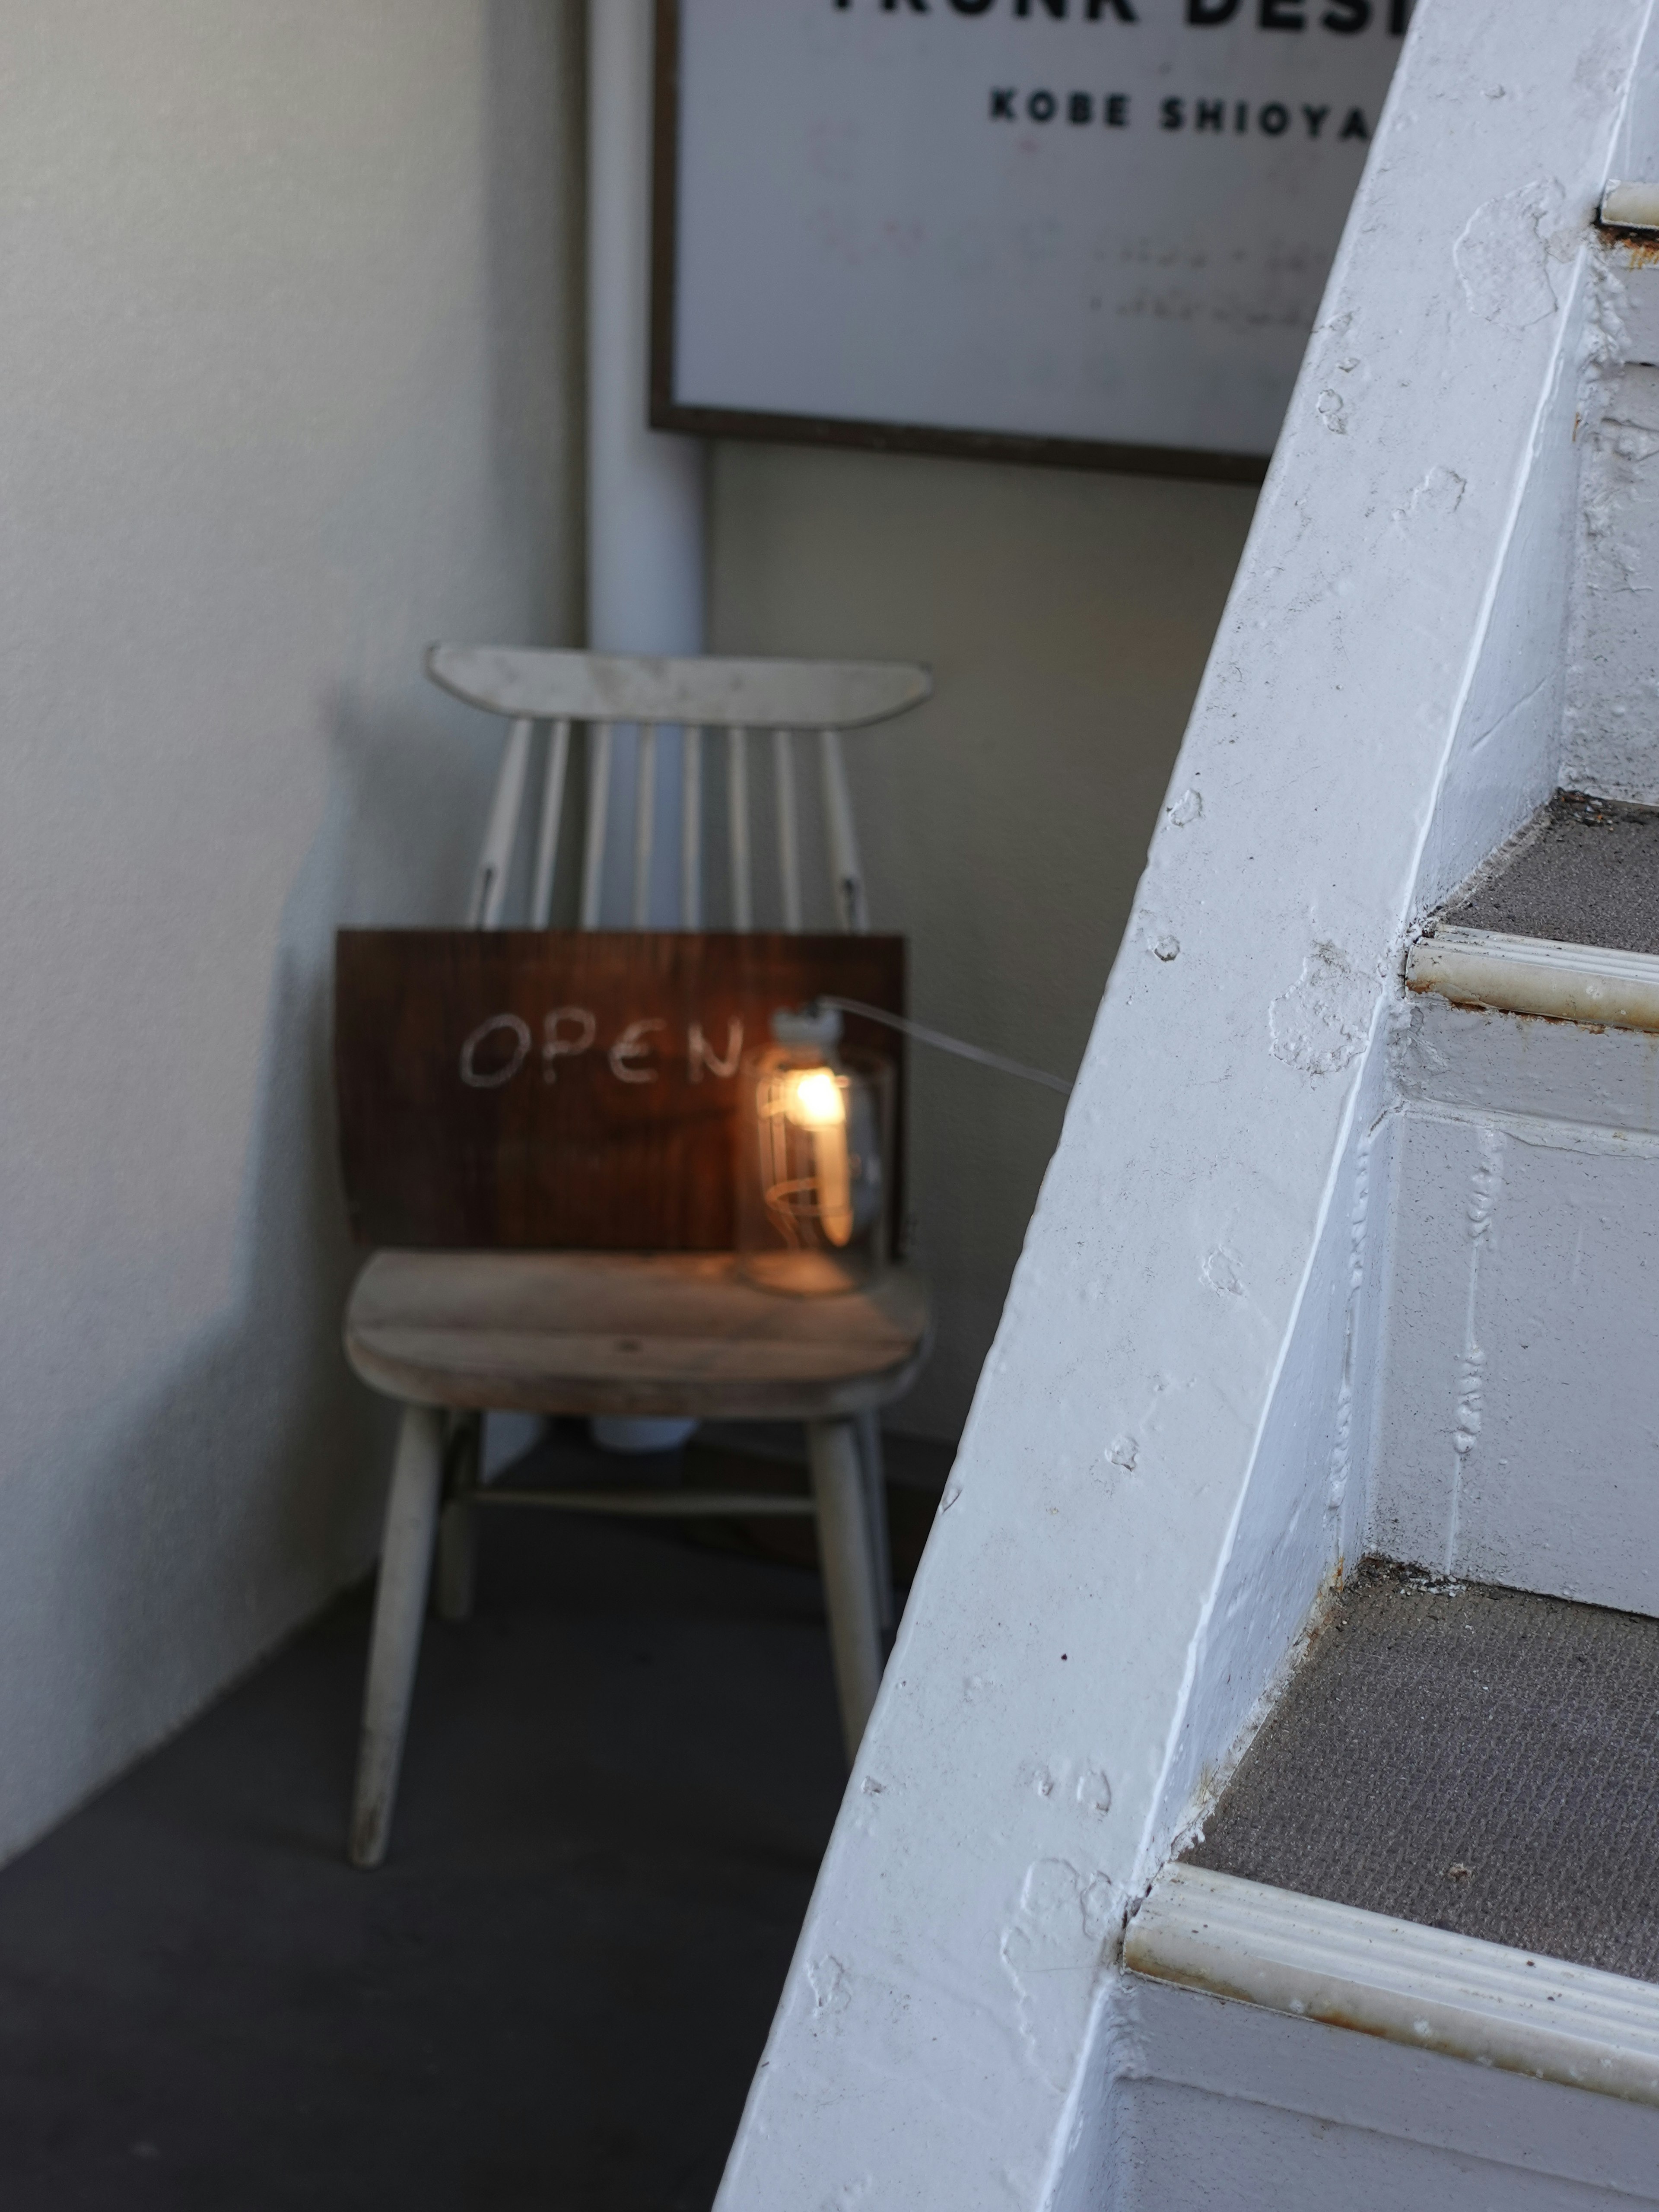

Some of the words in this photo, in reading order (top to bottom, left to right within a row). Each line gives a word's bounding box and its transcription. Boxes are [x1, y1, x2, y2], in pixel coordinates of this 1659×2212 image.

[990, 89, 1129, 128] KOBE
[1160, 96, 1369, 143] SHIOYA
[459, 1006, 744, 1087] OPEN
